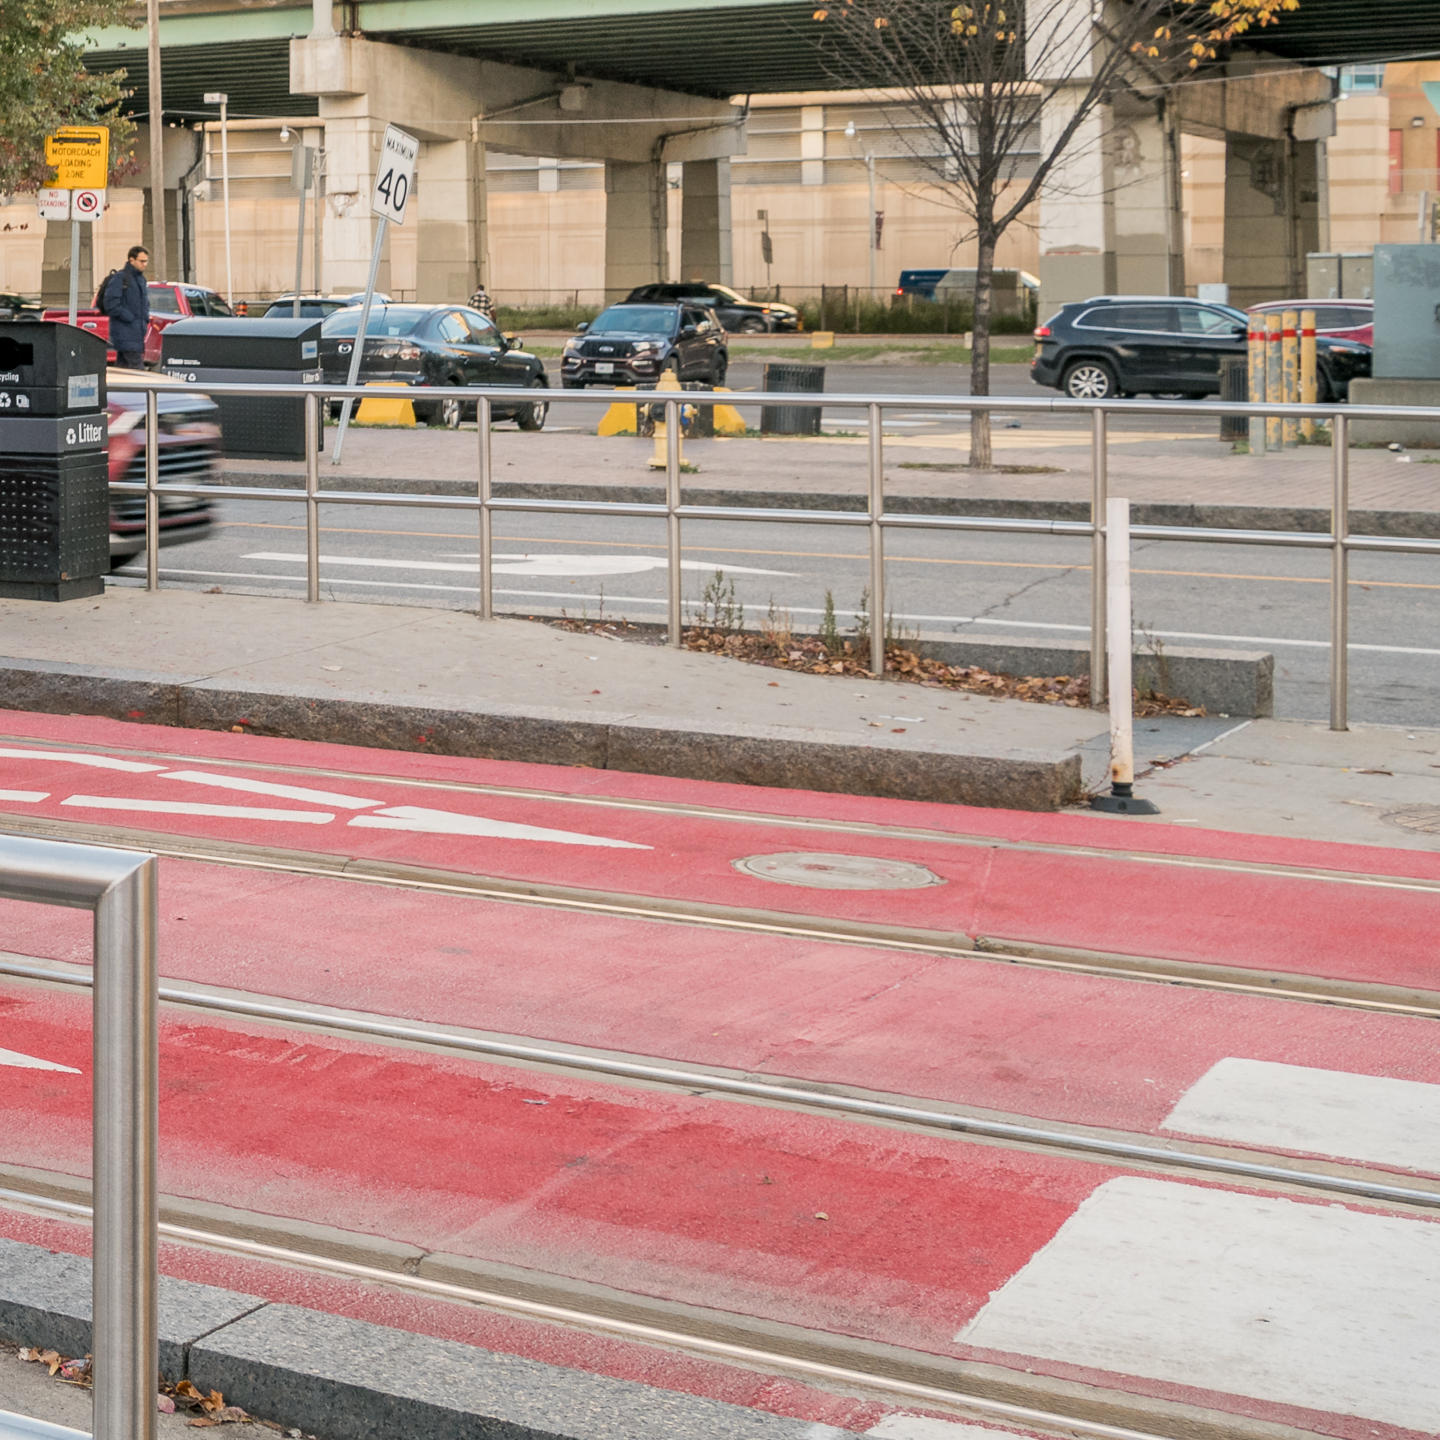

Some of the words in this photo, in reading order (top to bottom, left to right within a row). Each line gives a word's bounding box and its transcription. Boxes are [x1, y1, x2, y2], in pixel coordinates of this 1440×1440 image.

[52, 148, 100, 156] MOTORCOACH
[386, 137, 415, 162] MAXIMUM
[60, 159, 92, 168] LOADING
[378, 168, 407, 211] 40
[78, 422, 103, 443] Litter
